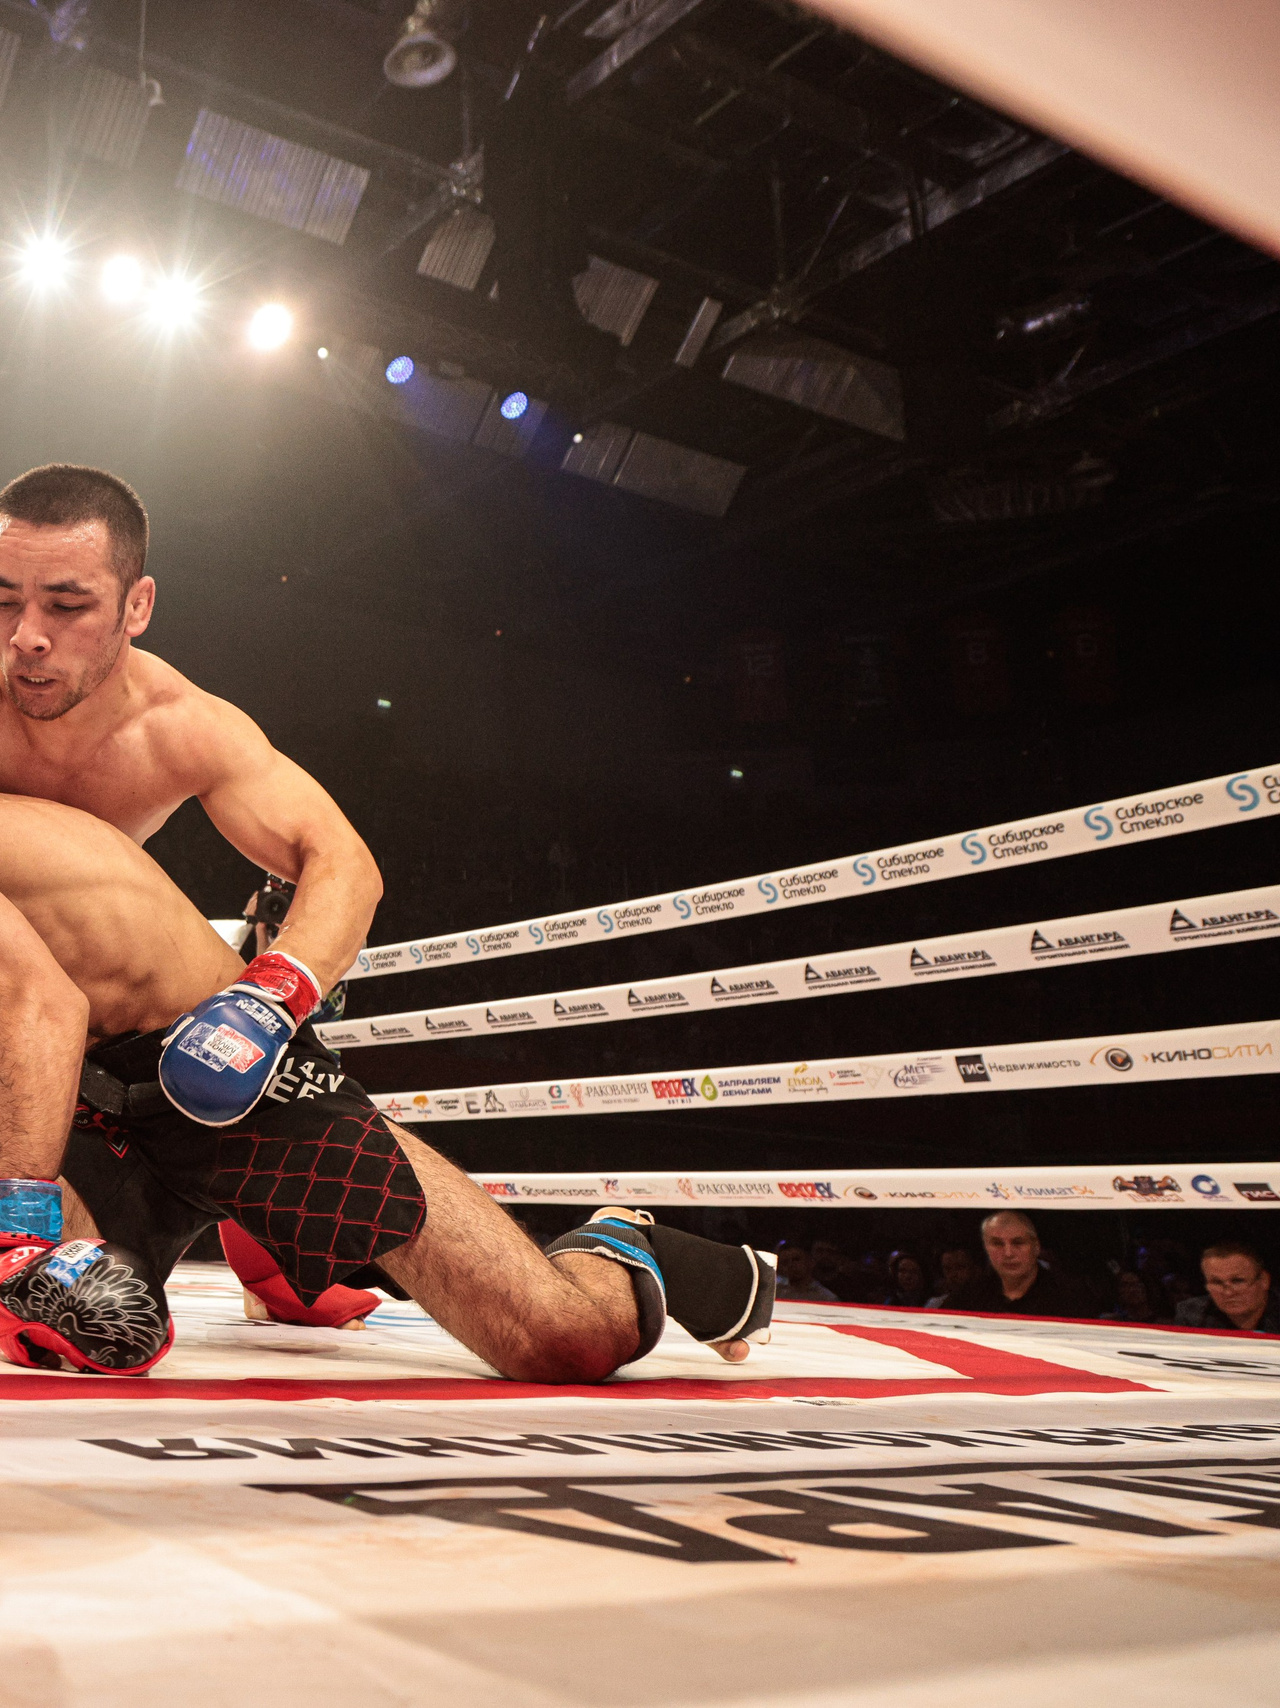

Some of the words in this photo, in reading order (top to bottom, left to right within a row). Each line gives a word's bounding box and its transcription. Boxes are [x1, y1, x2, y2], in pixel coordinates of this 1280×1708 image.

[1115, 792, 1203, 821] Сибирское
[1120, 812, 1184, 834] Стекло
[988, 821, 1065, 846] Сибирское
[877, 846, 944, 869] Сибирское
[992, 840, 1048, 859] Стекло
[779, 868, 838, 888] Сибирское
[881, 863, 930, 881] Стекло
[692, 886, 745, 906] Сибирское
[782, 882, 826, 900] Стекло
[614, 902, 662, 920] Сибирское
[696, 900, 734, 916] Стекло
[544, 917, 587, 932] Сибирское
[617, 917, 652, 930] Стекло
[1201, 909, 1280, 927] АВАНГАРД
[480, 930, 519, 944] Сибирское
[547, 929, 578, 942] Стекло
[1058, 930, 1125, 948] АВАНГАРД
[422, 940, 458, 954] Сибирское
[482, 940, 511, 953] Стекло
[424, 950, 451, 962] Стекло
[934, 950, 992, 964] АВАНГАРД
[825, 965, 876, 979] АВАНГАРД
[729, 979, 775, 992] АВАНГАРД
[989, 1058, 1081, 1073] Недвижимость
[586, 1081, 649, 1097] РАКОВАРНЯ
[651, 1078, 701, 1099] BROZEX
[718, 1076, 781, 1087] ЗАПРАВЛЯЕМ
[722, 1087, 772, 1097] ДЕНЬГАМИ
[698, 1182, 773, 1195] РАКОВАРНЯ
[77, 1429, 1027, 1462] КОМПАНИЯ
